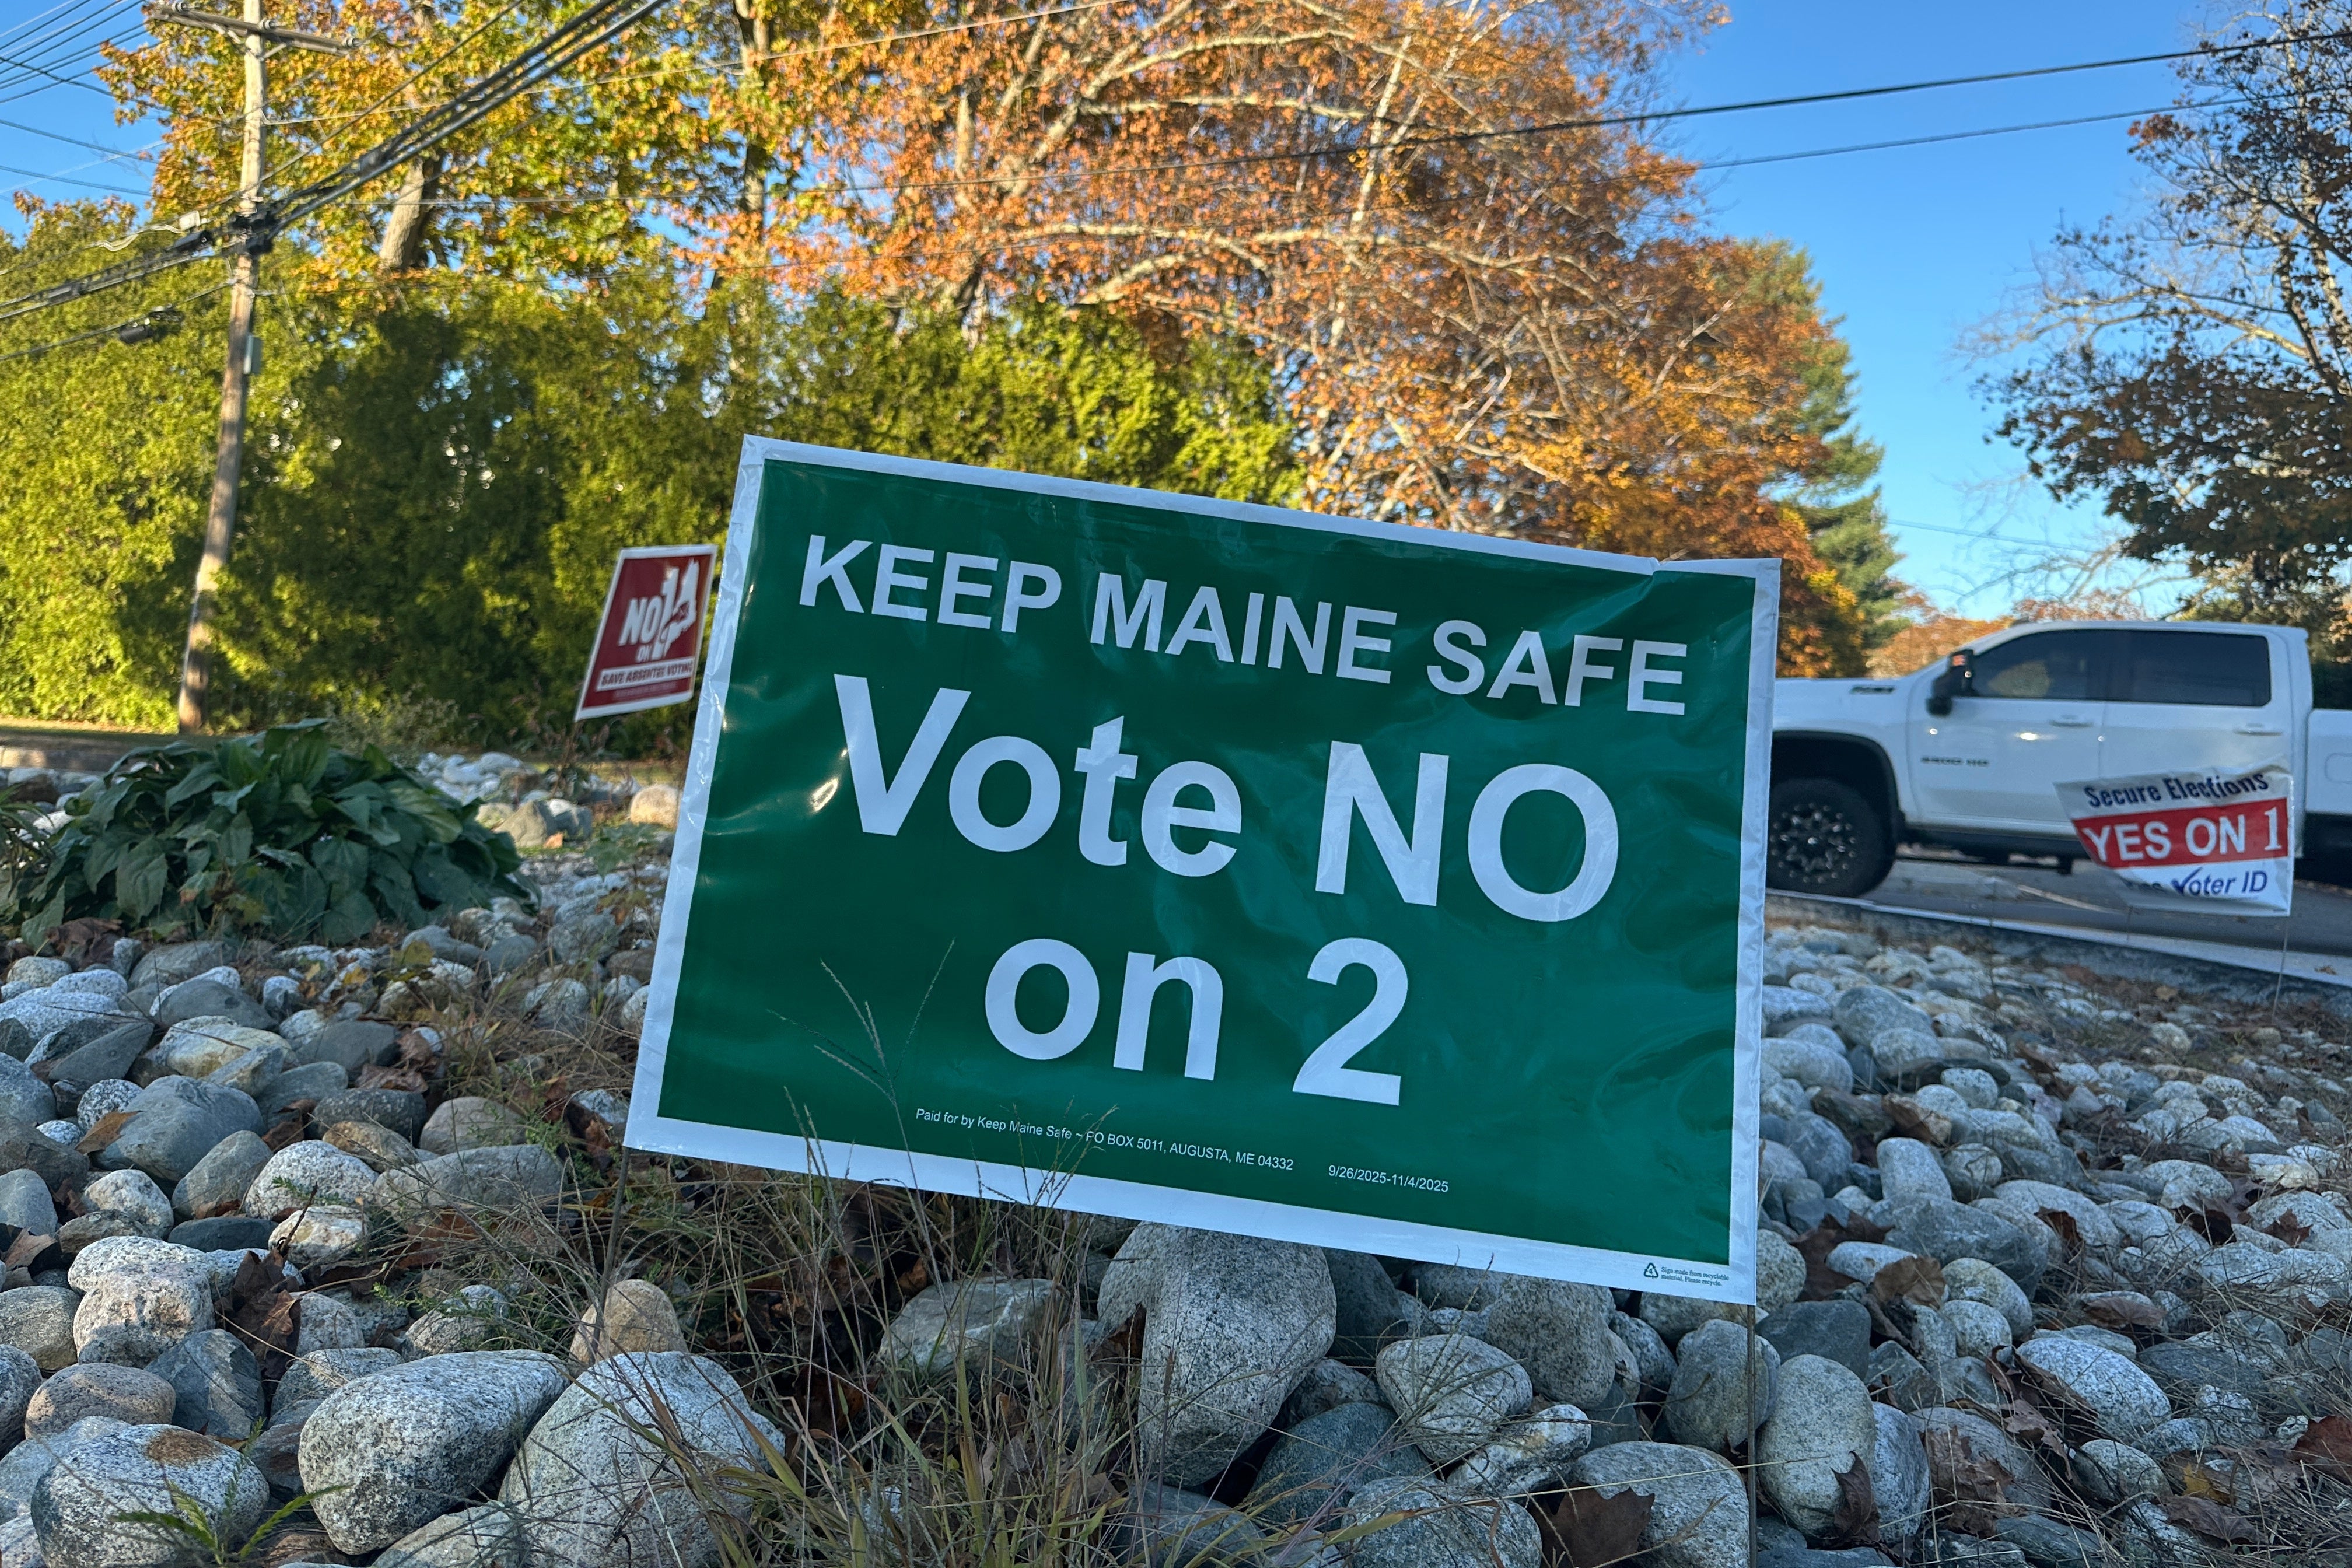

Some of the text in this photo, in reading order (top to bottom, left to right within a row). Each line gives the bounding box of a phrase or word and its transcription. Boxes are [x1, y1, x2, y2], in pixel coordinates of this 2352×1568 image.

[618, 595, 664, 646] NO
[800, 535, 1686, 715] KEEP MAINE SAFE
[601, 662, 693, 686] SAVE ABSENTEE VOTING
[834, 674, 1618, 921] Vote NO
[2084, 772, 2269, 807] Secure Elections
[2082, 807, 2282, 862] YES ON 1
[2241, 871, 2268, 894] ID
[986, 939, 1408, 1105] on 2
[916, 1108, 941, 1122] Paid
[943, 1112, 959, 1124] for
[961, 1115, 975, 1129] by
[977, 1116, 1006, 1132] Keep
[1009, 1121, 1043, 1135] Maine
[1046, 1125, 1072, 1139] Safe
[1107, 1134, 1134, 1148] BOX
[1137, 1138, 1167, 1154] 5011,
[1169, 1142, 1231, 1163] AUGUSTA,
[1236, 1152, 1255, 1165] ME
[1258, 1155, 1293, 1171] 04332
[1328, 1165, 1449, 1192] 9/26/2025-11/4/2025
